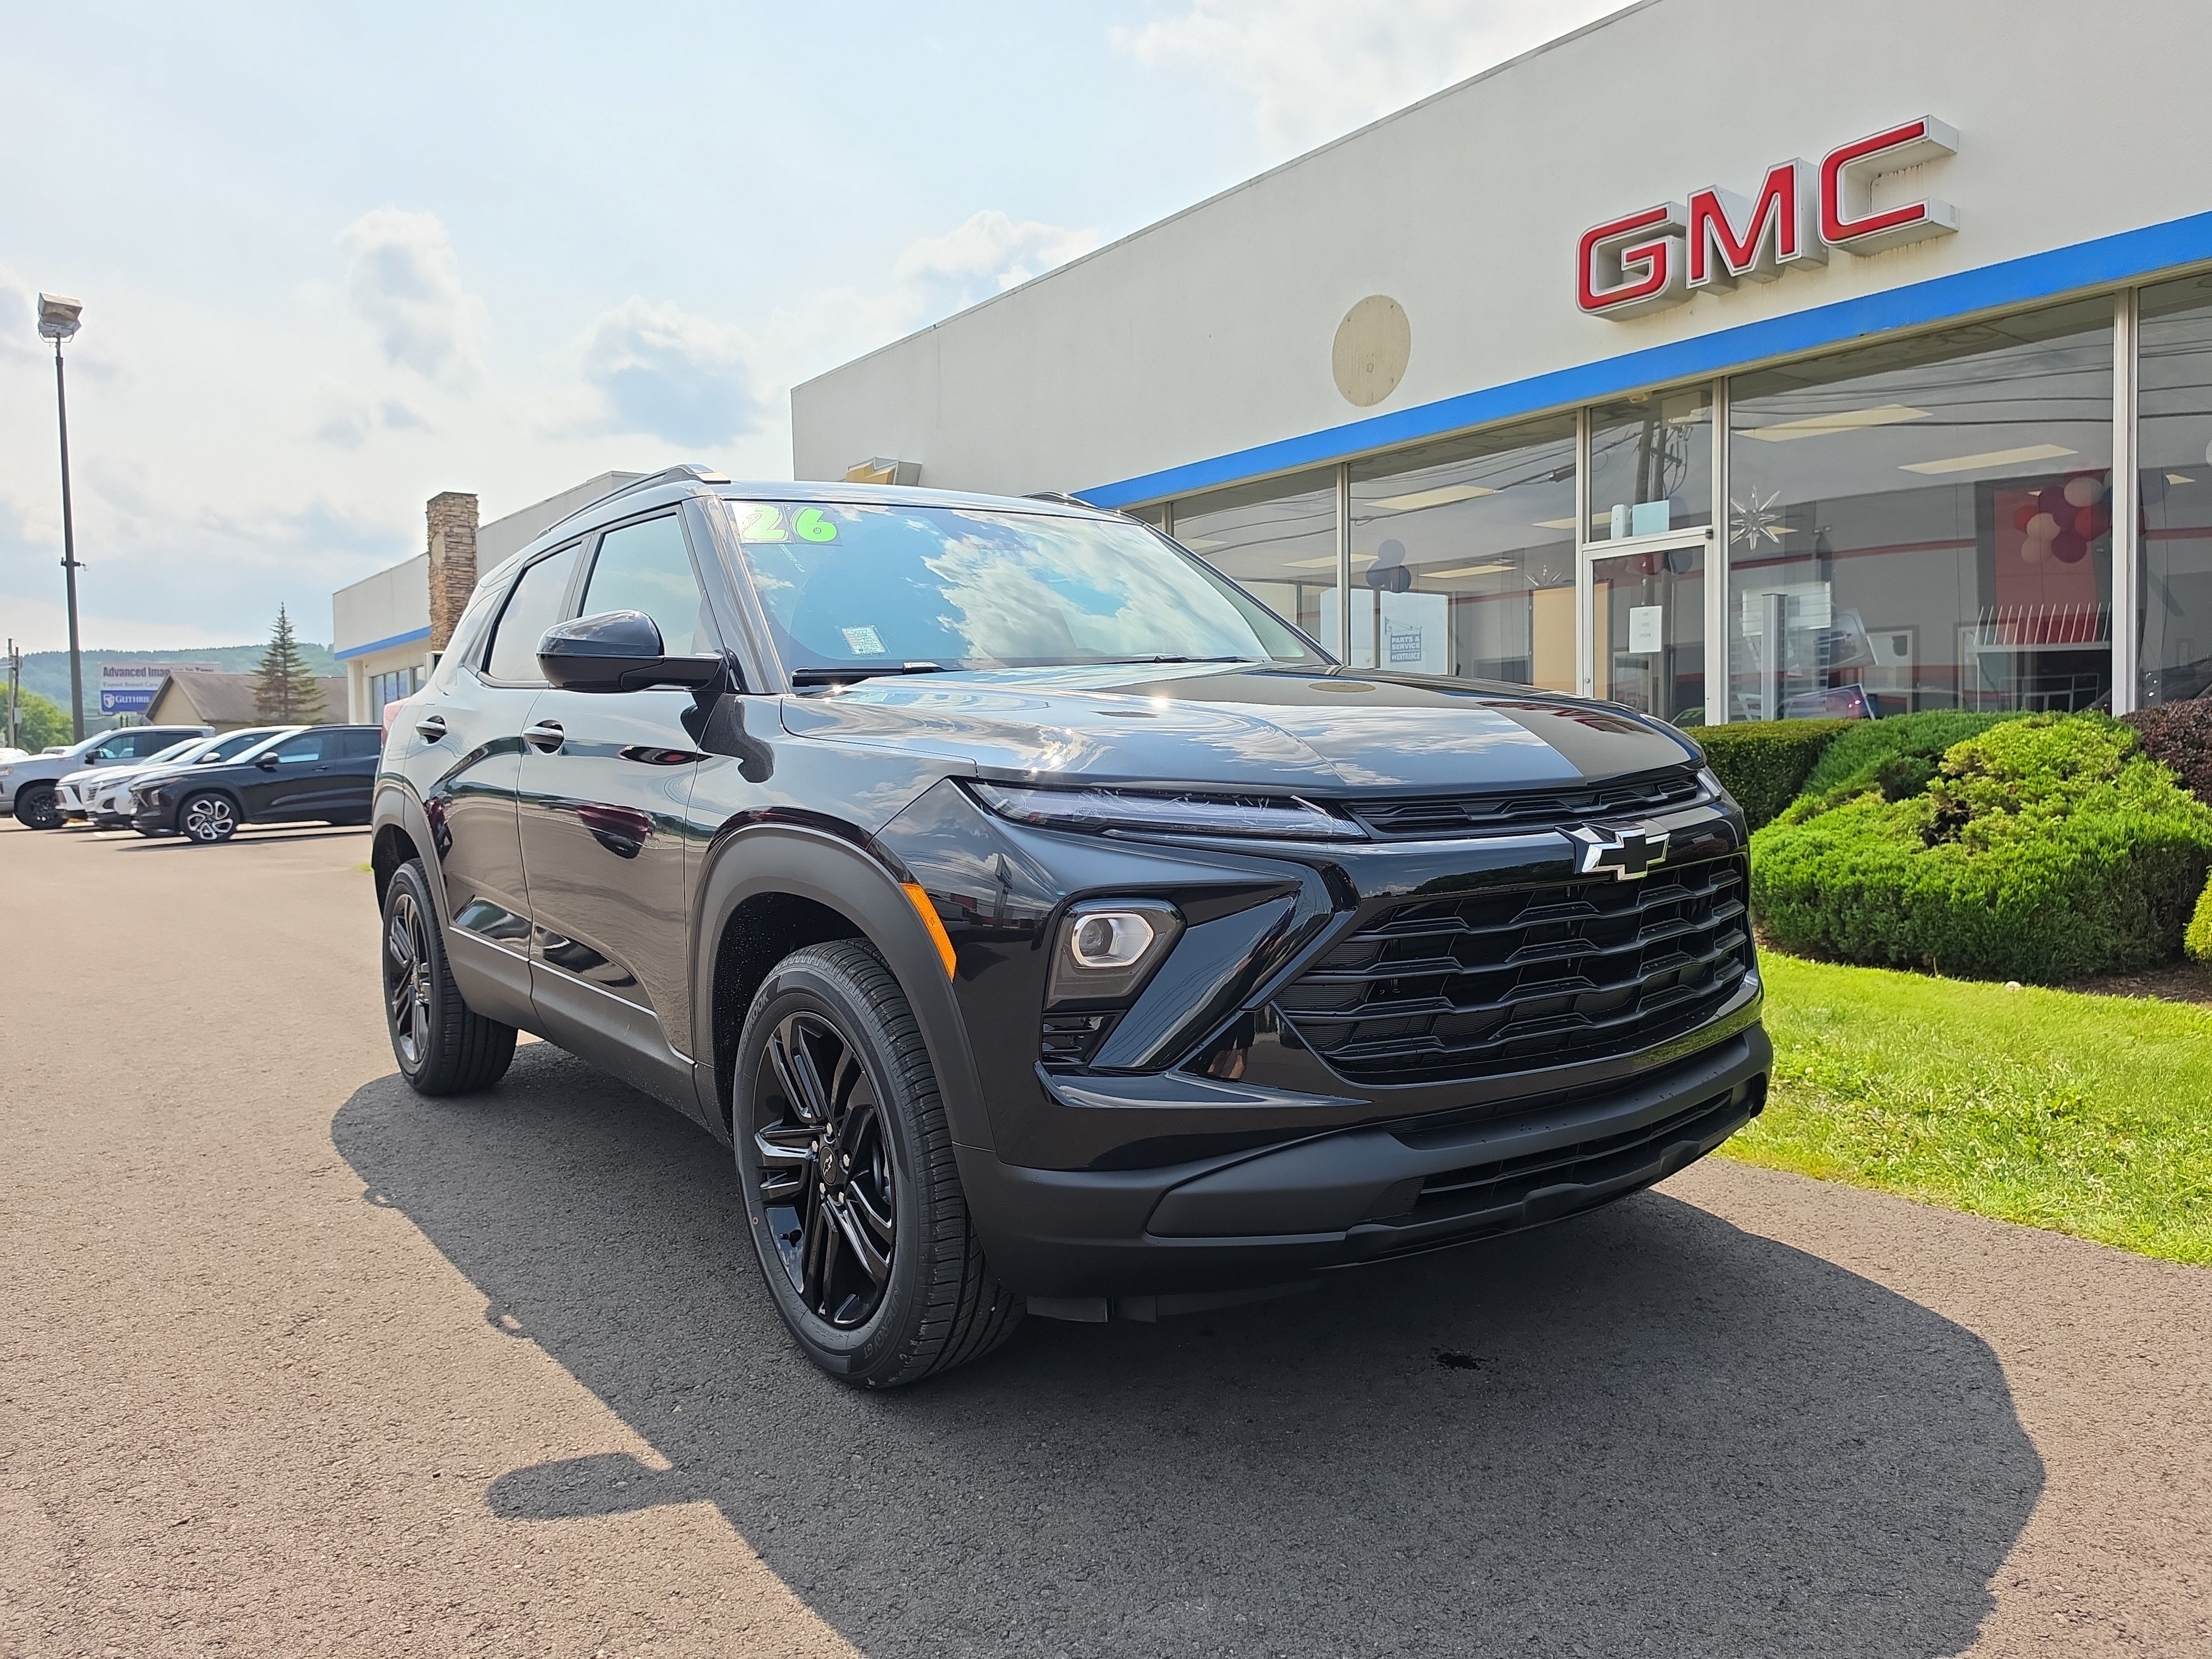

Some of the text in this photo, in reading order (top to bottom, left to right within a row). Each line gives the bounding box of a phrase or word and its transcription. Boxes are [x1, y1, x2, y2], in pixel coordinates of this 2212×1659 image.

[1577, 114, 1931, 316] GMC
[742, 504, 838, 542] 26
[1397, 652, 1420, 661] ENTRANCE
[103, 667, 146, 677] Advanced
[115, 695, 151, 704] GUTHRIE
